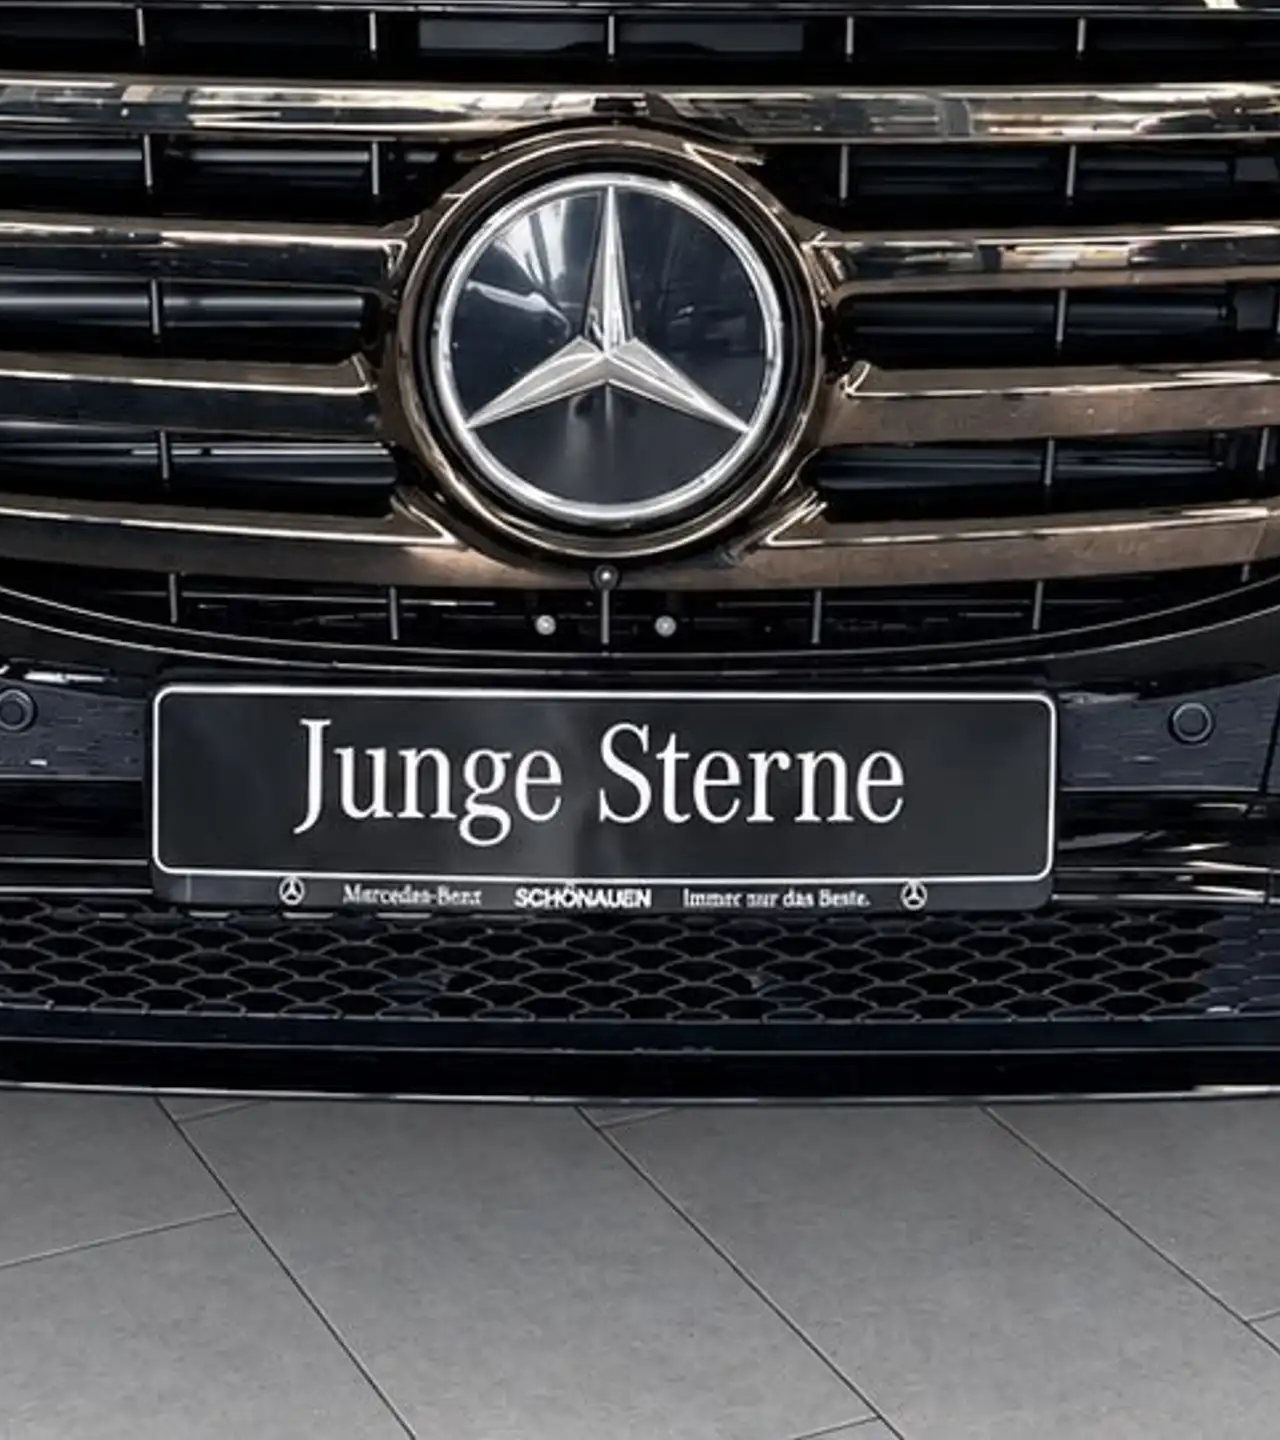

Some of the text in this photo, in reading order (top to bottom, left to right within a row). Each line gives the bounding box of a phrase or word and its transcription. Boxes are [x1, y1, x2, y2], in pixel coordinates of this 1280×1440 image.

[293, 718, 905, 847] Junge Sterne
[342, 881, 872, 909] Mercedes-Benz SCHÖNAUEN Immer nur das Beste.
